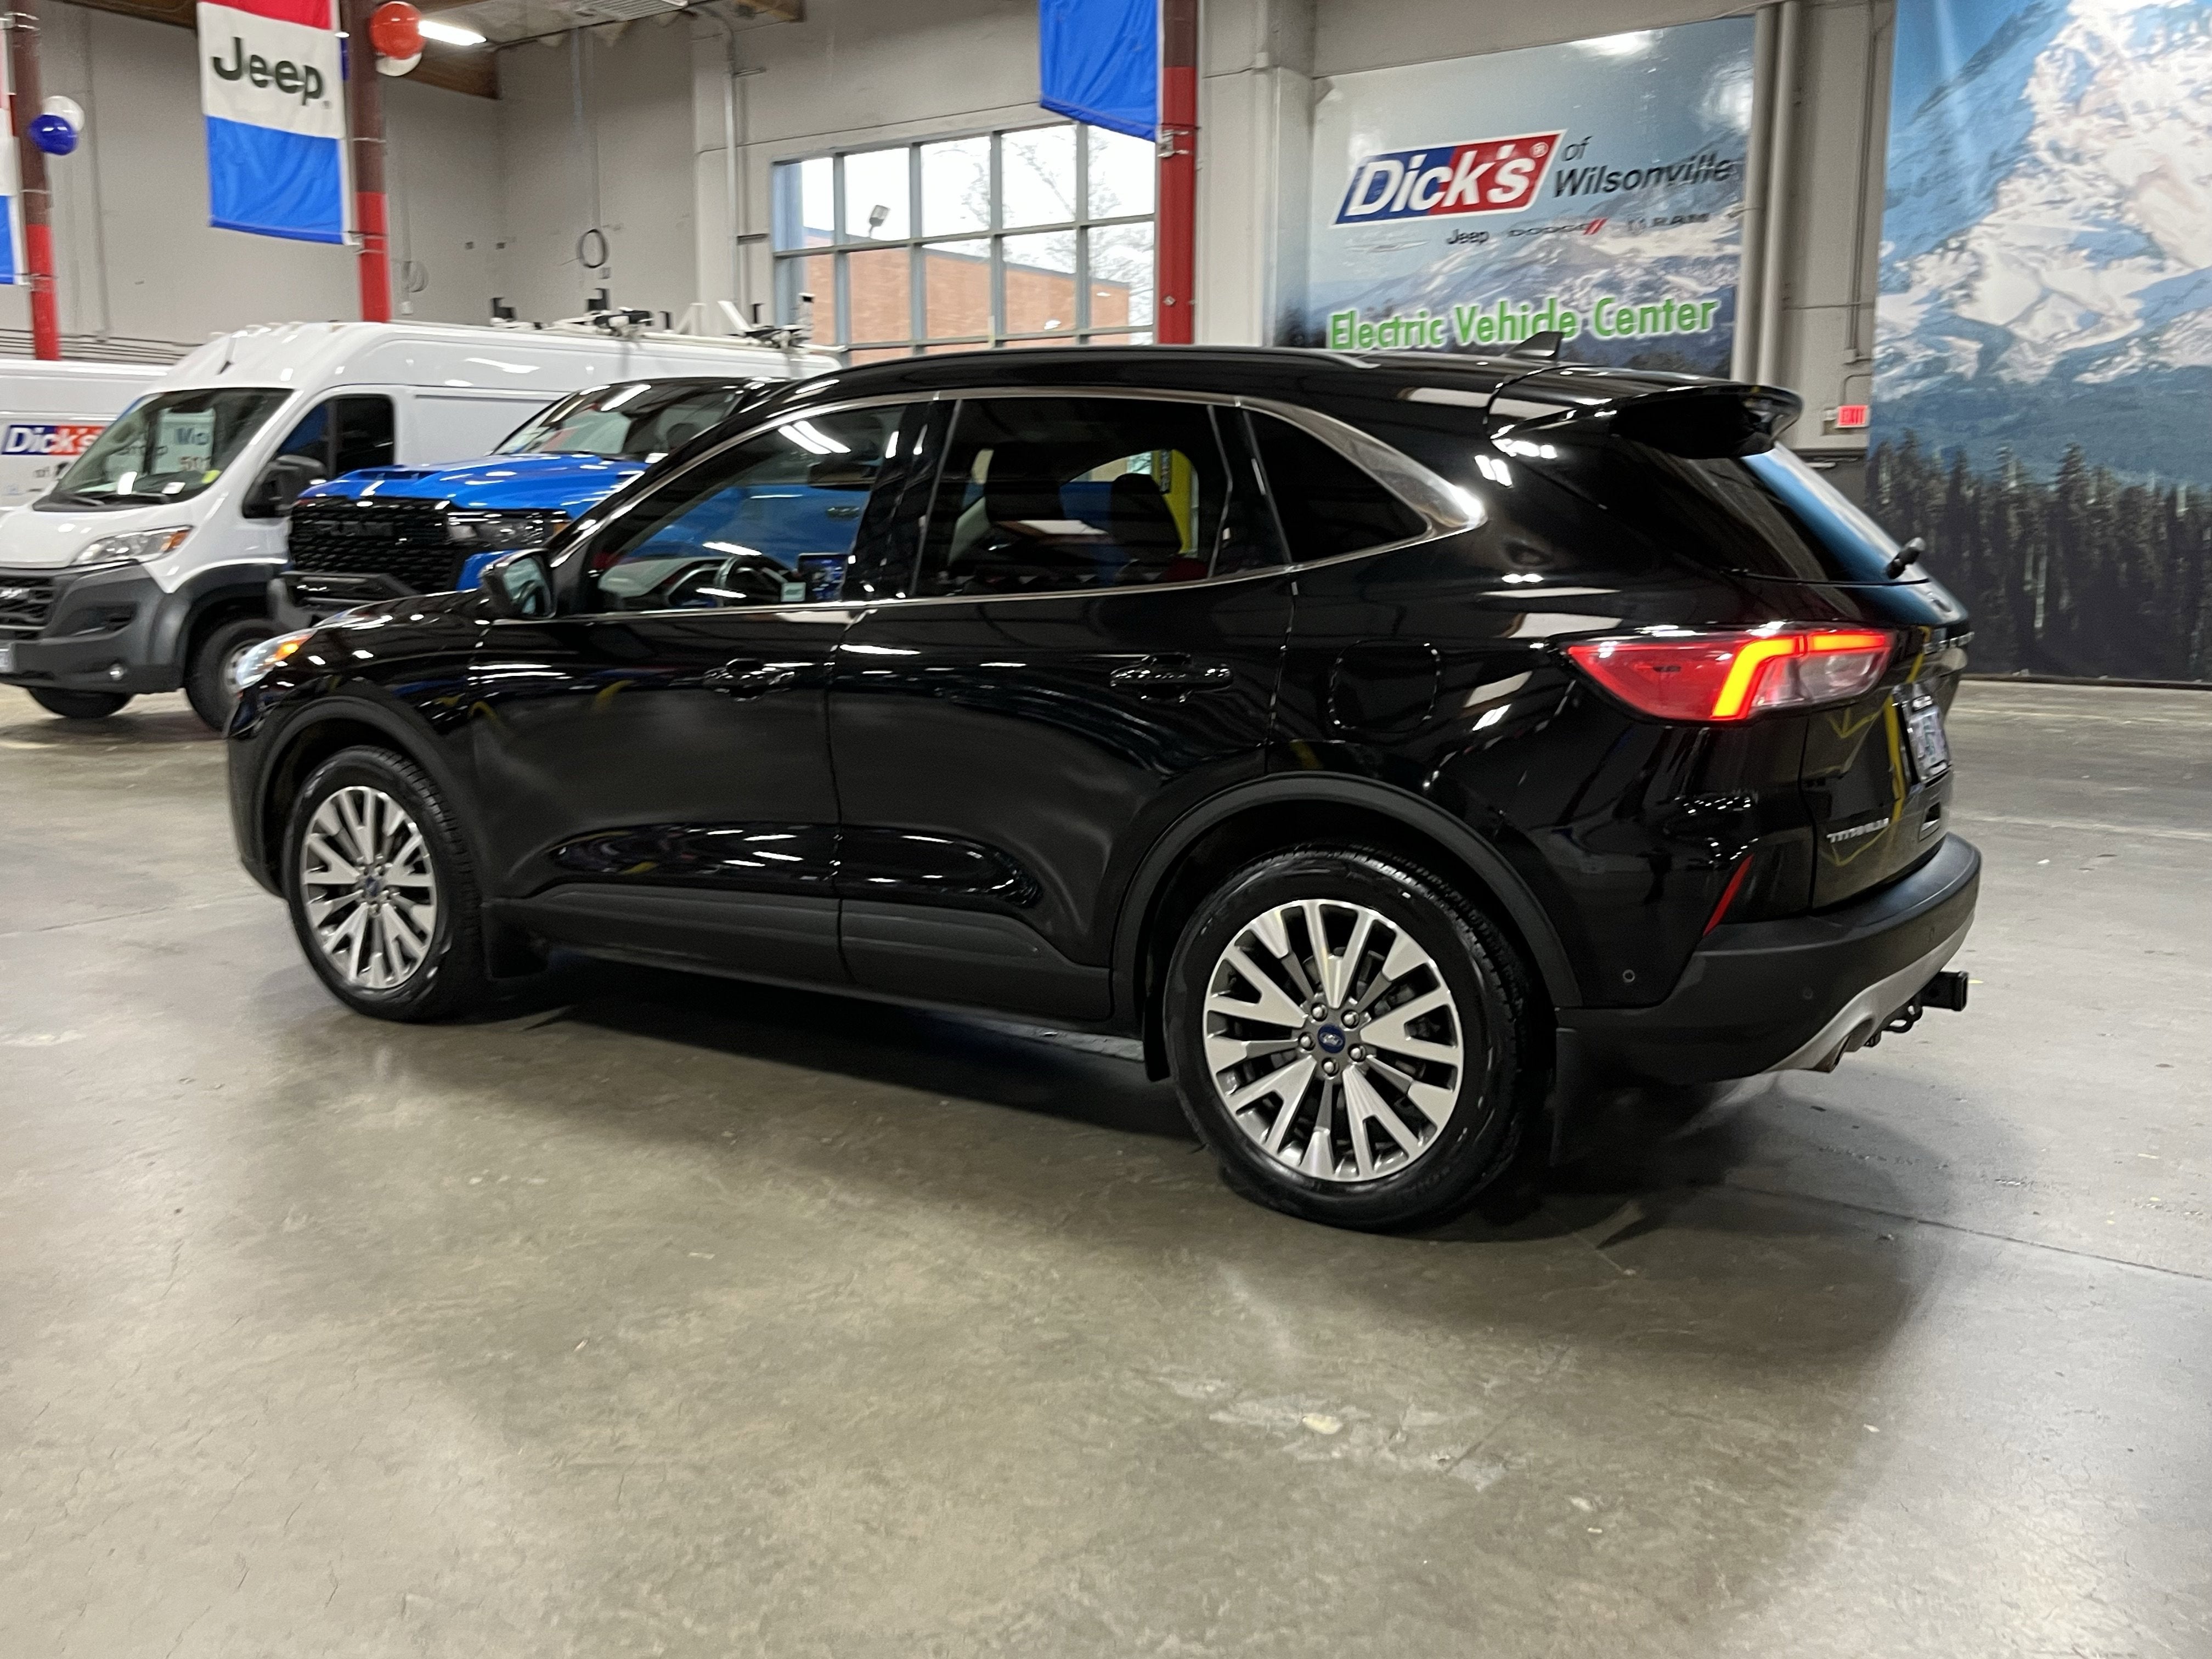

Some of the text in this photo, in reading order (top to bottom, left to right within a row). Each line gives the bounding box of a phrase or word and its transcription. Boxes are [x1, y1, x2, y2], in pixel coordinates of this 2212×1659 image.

[211, 36, 324, 106] Jeep
[1562, 136, 1593, 161] of
[1344, 144, 1536, 217] Dick's
[1554, 150, 1735, 198] Wilsonville
[1446, 228, 1490, 246] Jeep
[1331, 297, 1719, 350] Electric Vehicle Center
[1841, 407, 1865, 425] EXIT
